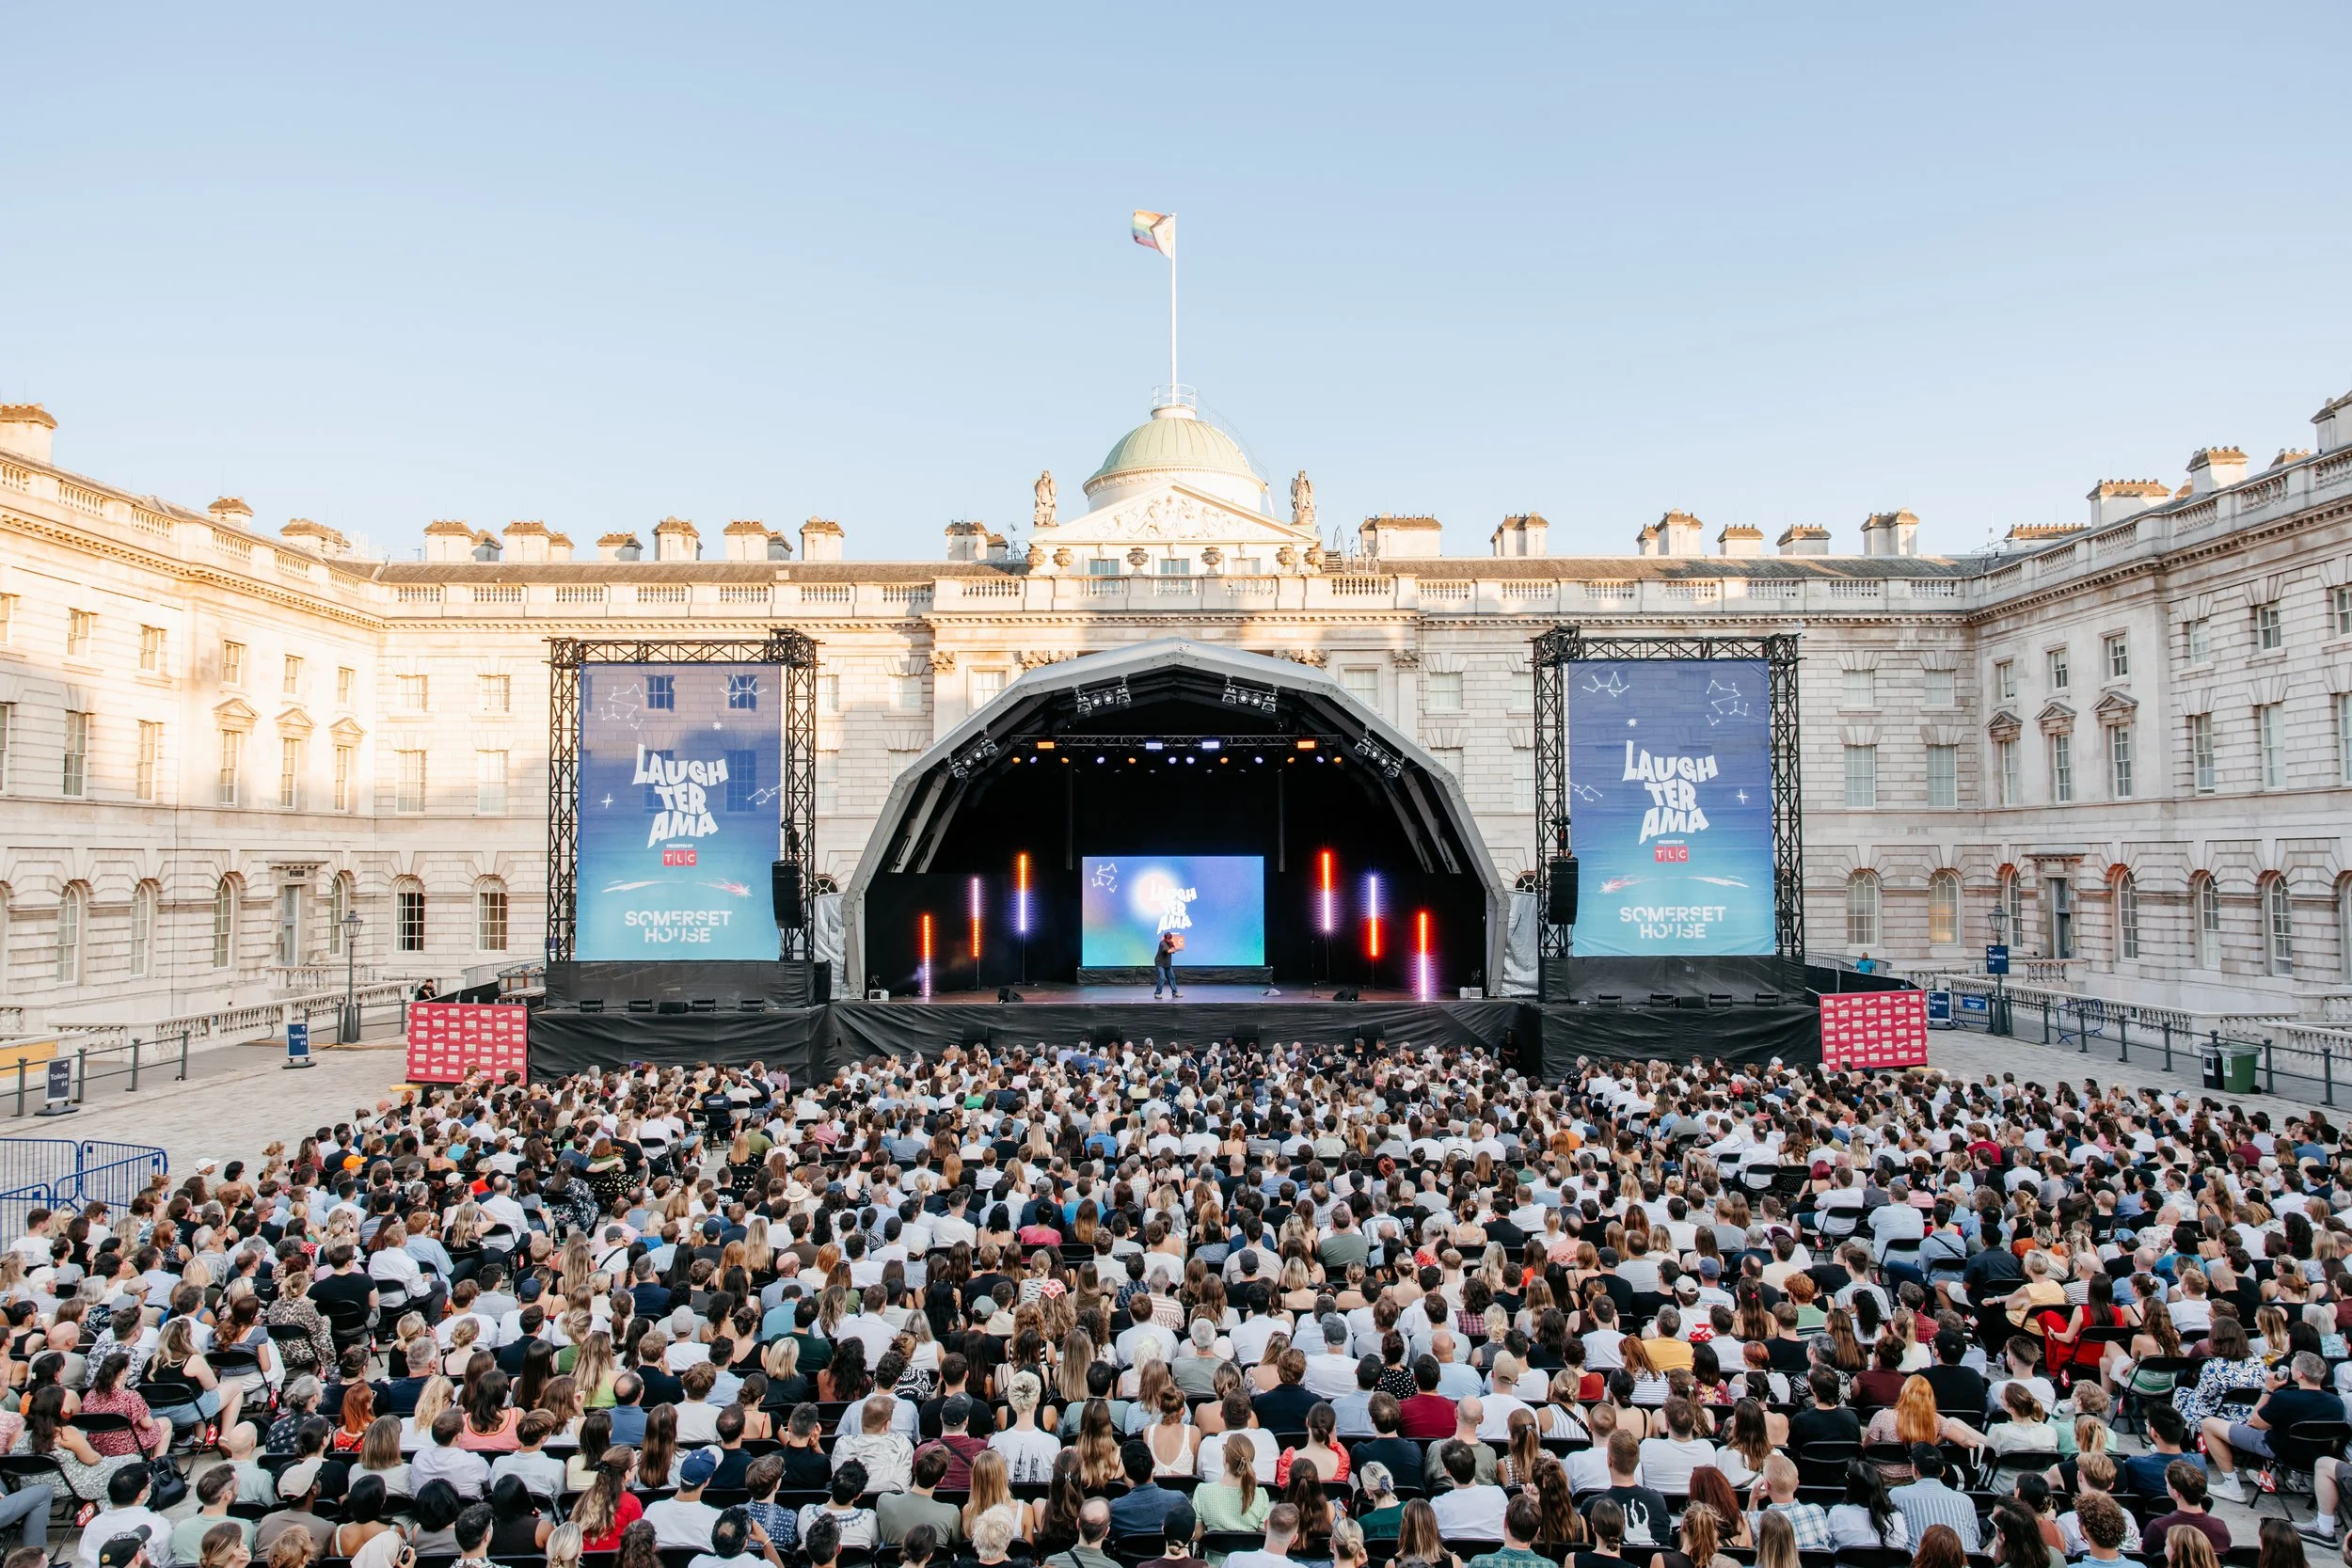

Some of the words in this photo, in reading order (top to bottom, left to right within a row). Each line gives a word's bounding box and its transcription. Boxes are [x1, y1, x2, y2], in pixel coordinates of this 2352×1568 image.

[632, 743, 729, 786] LAUGH
[1622, 739, 1719, 783] LAUGH
[654, 782, 707, 815] TER
[1645, 779, 1696, 811] TER
[647, 811, 719, 848] AMA
[1638, 806, 1710, 845] AMA
[664, 853, 695, 863] TLC
[1656, 849, 1686, 859] TLC
[625, 911, 732, 927] SOMERSET
[1619, 907, 1726, 922] SOMERSET
[644, 927, 711, 942] HOUSE
[1641, 924, 1706, 939] HOUSE
[50, 1072, 69, 1081] Toilets
[2259, 1473, 2275, 1490] AA
